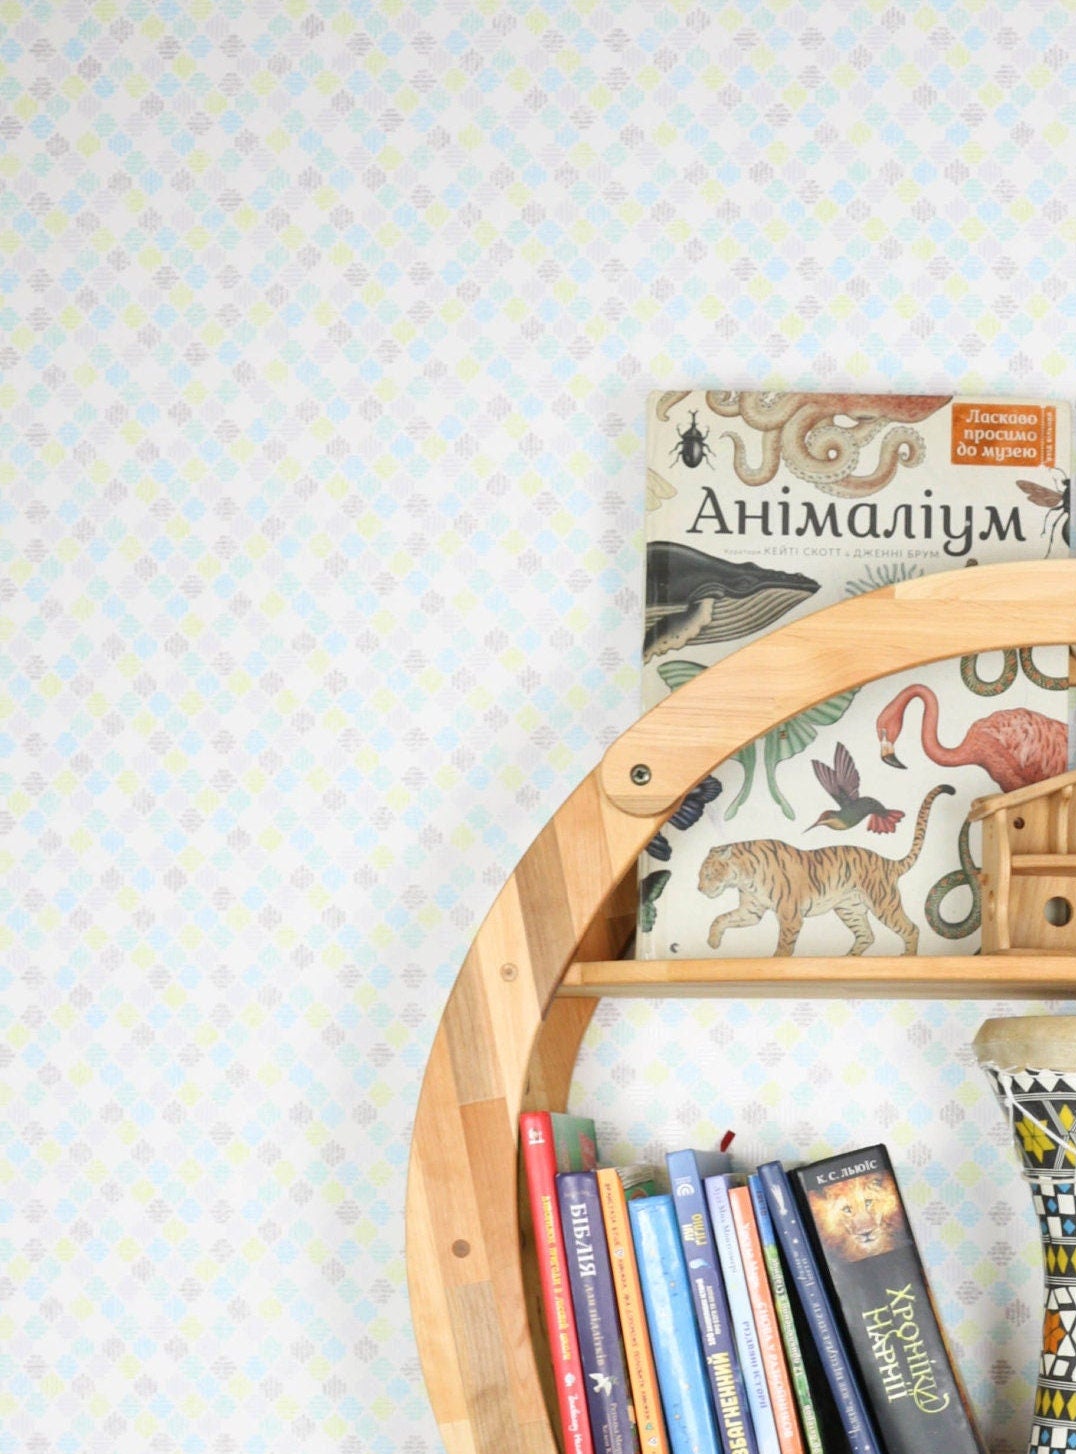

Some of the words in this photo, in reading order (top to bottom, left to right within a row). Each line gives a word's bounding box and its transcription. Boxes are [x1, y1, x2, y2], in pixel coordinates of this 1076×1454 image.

[965, 409, 1038, 425] Ласкаво
[963, 428, 1038, 444] просимо
[956, 441, 977, 457] до
[981, 445, 1037, 461] музею
[685, 485, 1027, 557] Анімаліум
[764, 545, 799, 556] КЕЙТІ
[803, 547, 842, 557] СКОТТ
[853, 548, 903, 559] ДЖЕННІ
[907, 549, 940, 559] БРУМ
[570, 1201, 595, 1278] БІБЛІЯ
[584, 1283, 595, 1306] для
[589, 1308, 605, 1367] підлітків
[740, 1320, 759, 1368] РІЗДВЯНІ
[792, 1364, 803, 1377] 12
